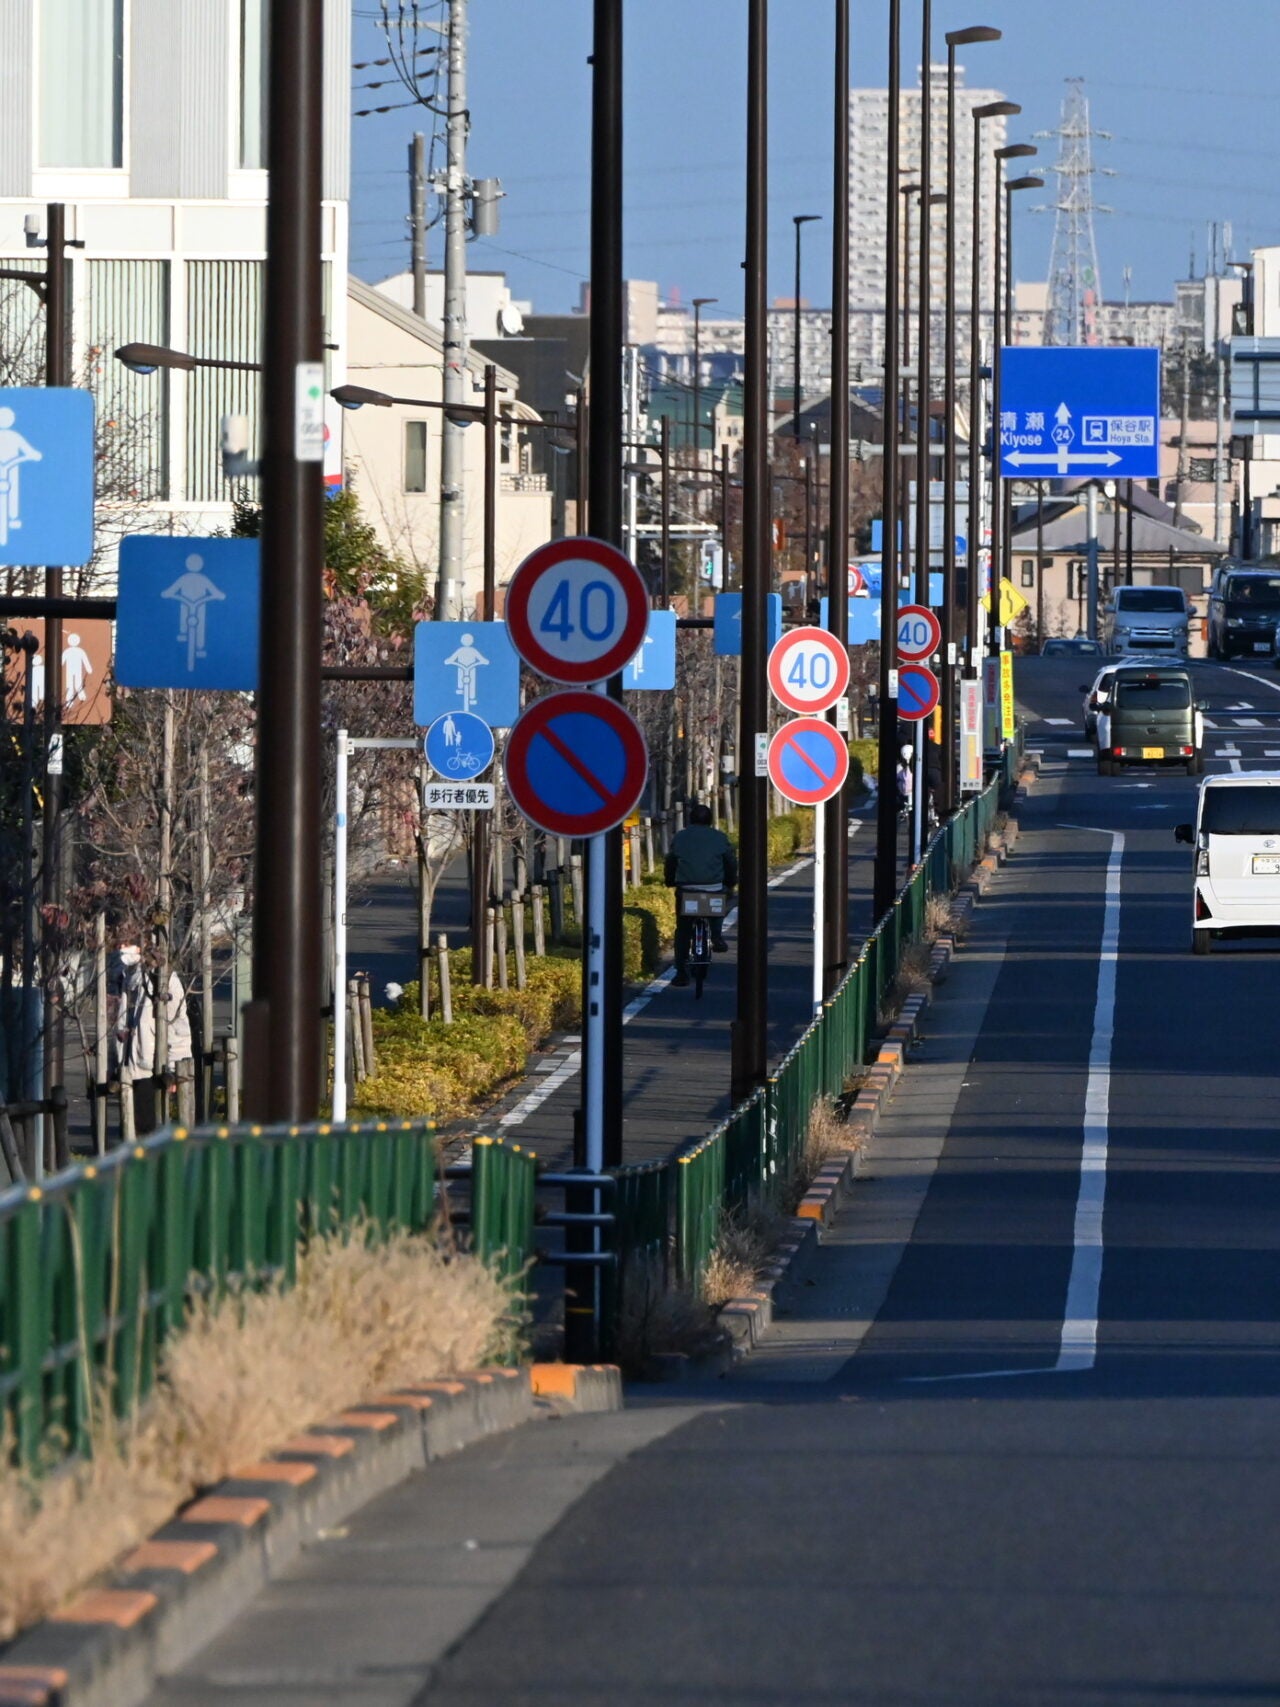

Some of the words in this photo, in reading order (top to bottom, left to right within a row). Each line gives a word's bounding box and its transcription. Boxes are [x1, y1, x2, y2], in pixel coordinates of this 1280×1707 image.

[1000, 412, 1045, 431] 清瀬
[1110, 419, 1152, 433] 保谷駅
[1000, 432, 1043, 449] Kiyose
[1056, 429, 1070, 441] 24
[1111, 433, 1132, 445] Hoya
[1134, 433, 1152, 444] Sta.
[540, 580, 615, 641] 40
[898, 621, 927, 645] 40
[788, 652, 831, 689] 40
[430, 788, 489, 803] 歩行者優先
